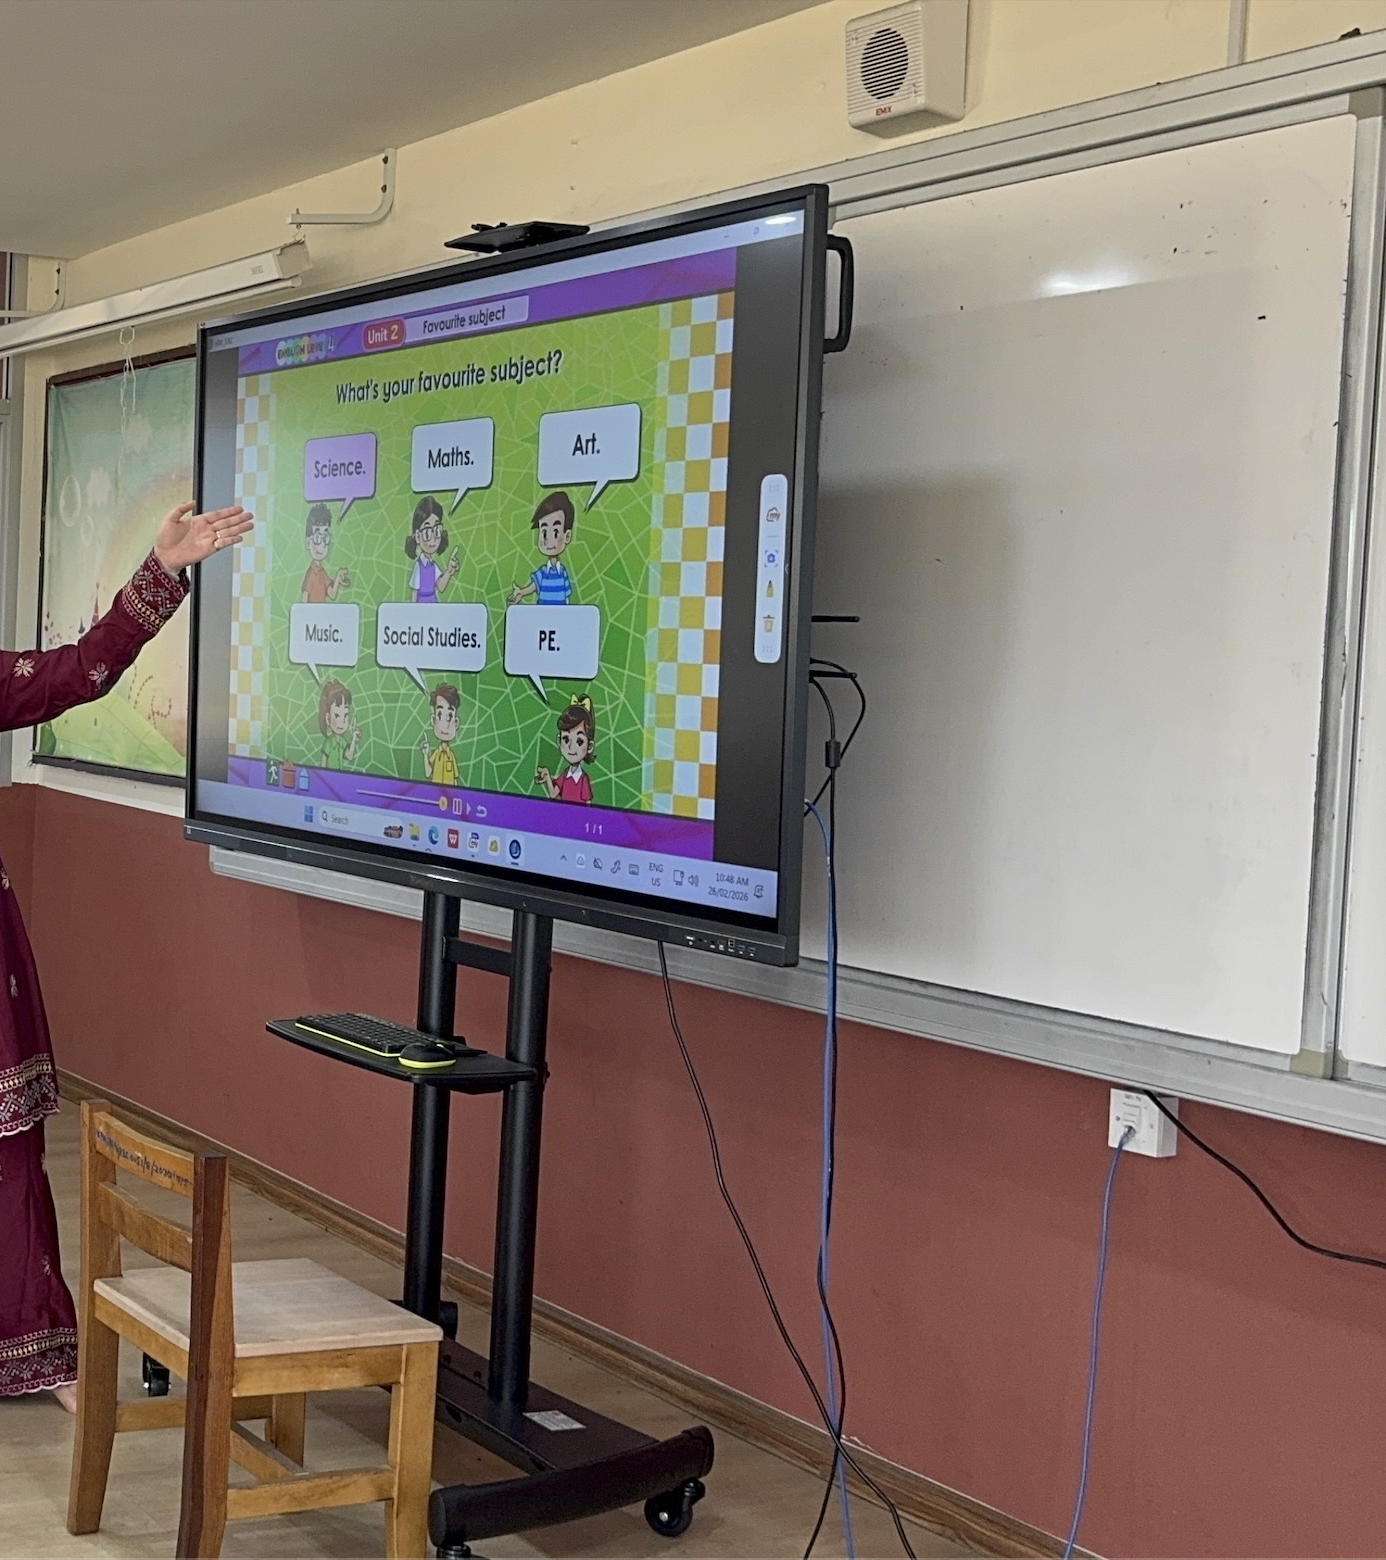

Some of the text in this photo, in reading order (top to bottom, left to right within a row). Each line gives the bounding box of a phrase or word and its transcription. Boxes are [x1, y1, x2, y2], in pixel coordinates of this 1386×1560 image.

[422, 305, 506, 335] Favourite subject
[367, 324, 399, 345] Unit 2
[335, 349, 563, 404] What's your favourite subject?
[571, 432, 601, 456] Art.
[427, 446, 474, 469] Maths.
[313, 459, 366, 479] Science.
[304, 623, 343, 643] Music.
[383, 625, 481, 649] Social Studies.
[538, 629, 561, 651] PE.
[330, 815, 349, 826] Search
[648, 861, 664, 873] ENG
[651, 876, 661, 888] US
[735, 875, 749, 887] AM
[708, 885, 749, 902] 26/02/2026
